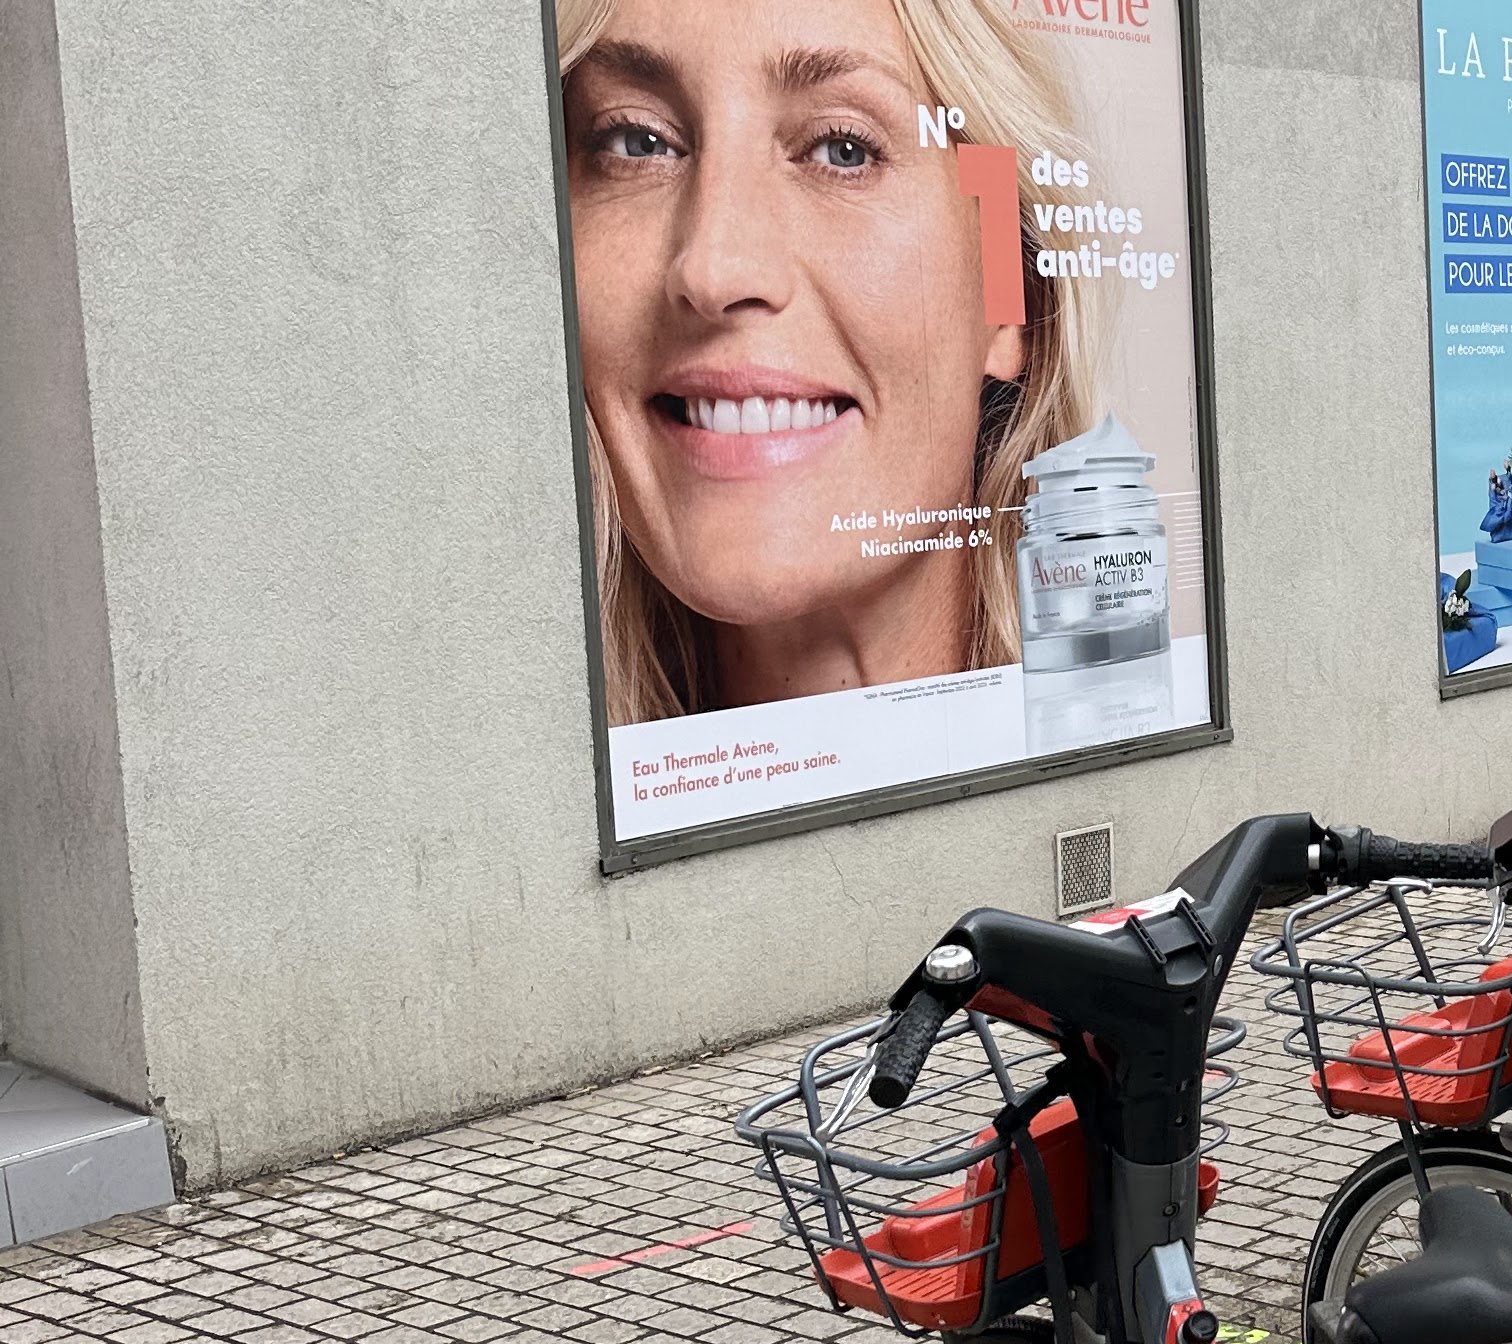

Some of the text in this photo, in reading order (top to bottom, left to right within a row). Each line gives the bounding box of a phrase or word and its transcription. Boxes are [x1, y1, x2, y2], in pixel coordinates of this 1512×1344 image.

[1012, 18, 1072, 36] LABORATOIRE
[1436, 27, 1487, 79] LA
[1031, 149, 1090, 189] des
[1445, 160, 1508, 190] OFFREZ
[1033, 199, 1144, 235] ventes
[1447, 211, 1469, 237] DE
[1473, 213, 1494, 238] LA
[956, 142, 1027, 326] 1
[1448, 261, 1495, 287] POUR
[1445, 321, 1459, 335] Les
[1460, 320, 1509, 337] cosmétiques
[830, 502, 993, 533] Acide Hyaluronique
[860, 528, 994, 559] Niacinamide 6%
[1031, 549, 1153, 587] Avène HYALURON
[1094, 566, 1144, 588] ACTIV B3
[632, 739, 780, 778] Eau Thermale Avène,
[633, 783, 649, 802] la
[652, 774, 720, 798] confiance
[766, 760, 800, 781] peau
[803, 750, 842, 770] saine.
